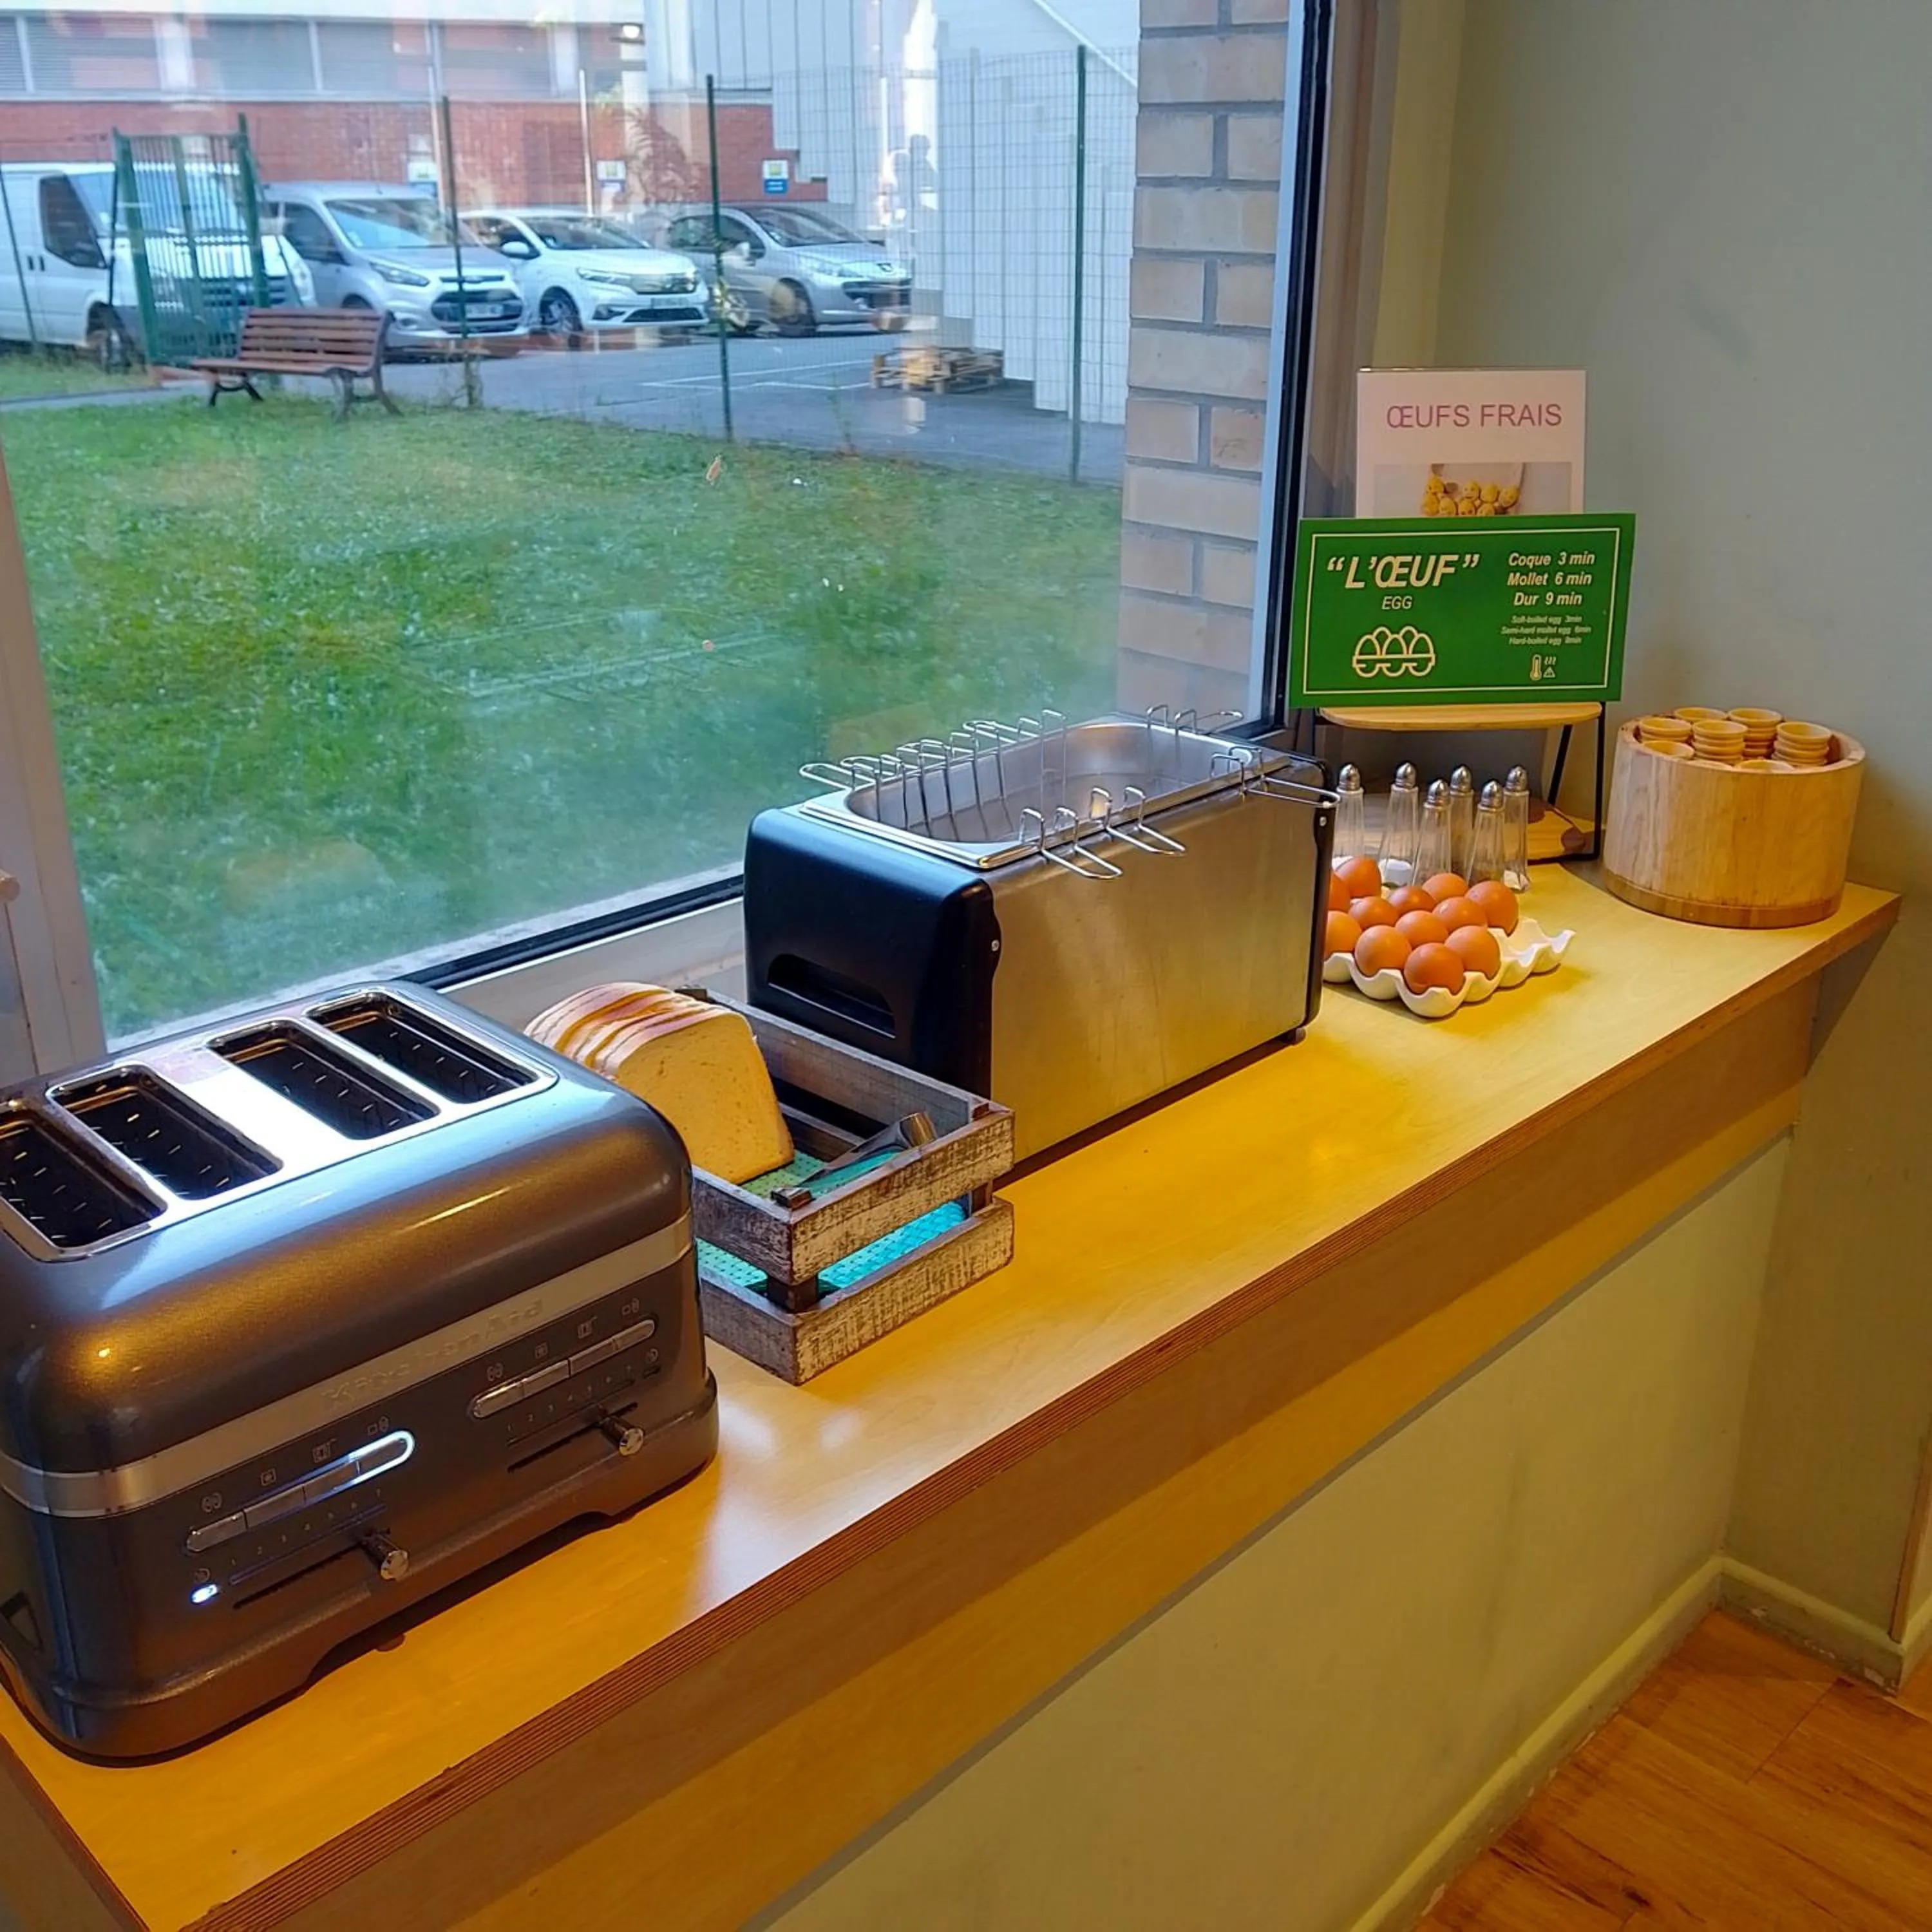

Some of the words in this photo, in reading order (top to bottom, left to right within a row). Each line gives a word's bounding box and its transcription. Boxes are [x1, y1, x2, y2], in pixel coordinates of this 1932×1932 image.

[1387, 404, 1471, 428] ŒUFS
[1480, 403, 1562, 427] FRAIS
[1508, 552, 1551, 569] Coque
[1557, 551, 1567, 565] 3
[1569, 551, 1596, 565] min
[1507, 572, 1549, 586] Mollet
[1555, 571, 1564, 585] 6
[1566, 571, 1593, 585] min
[1381, 596, 1413, 611] EGG
[1514, 592, 1540, 605] Dur
[1545, 591, 1555, 605] 9
[1556, 591, 1583, 605] min
